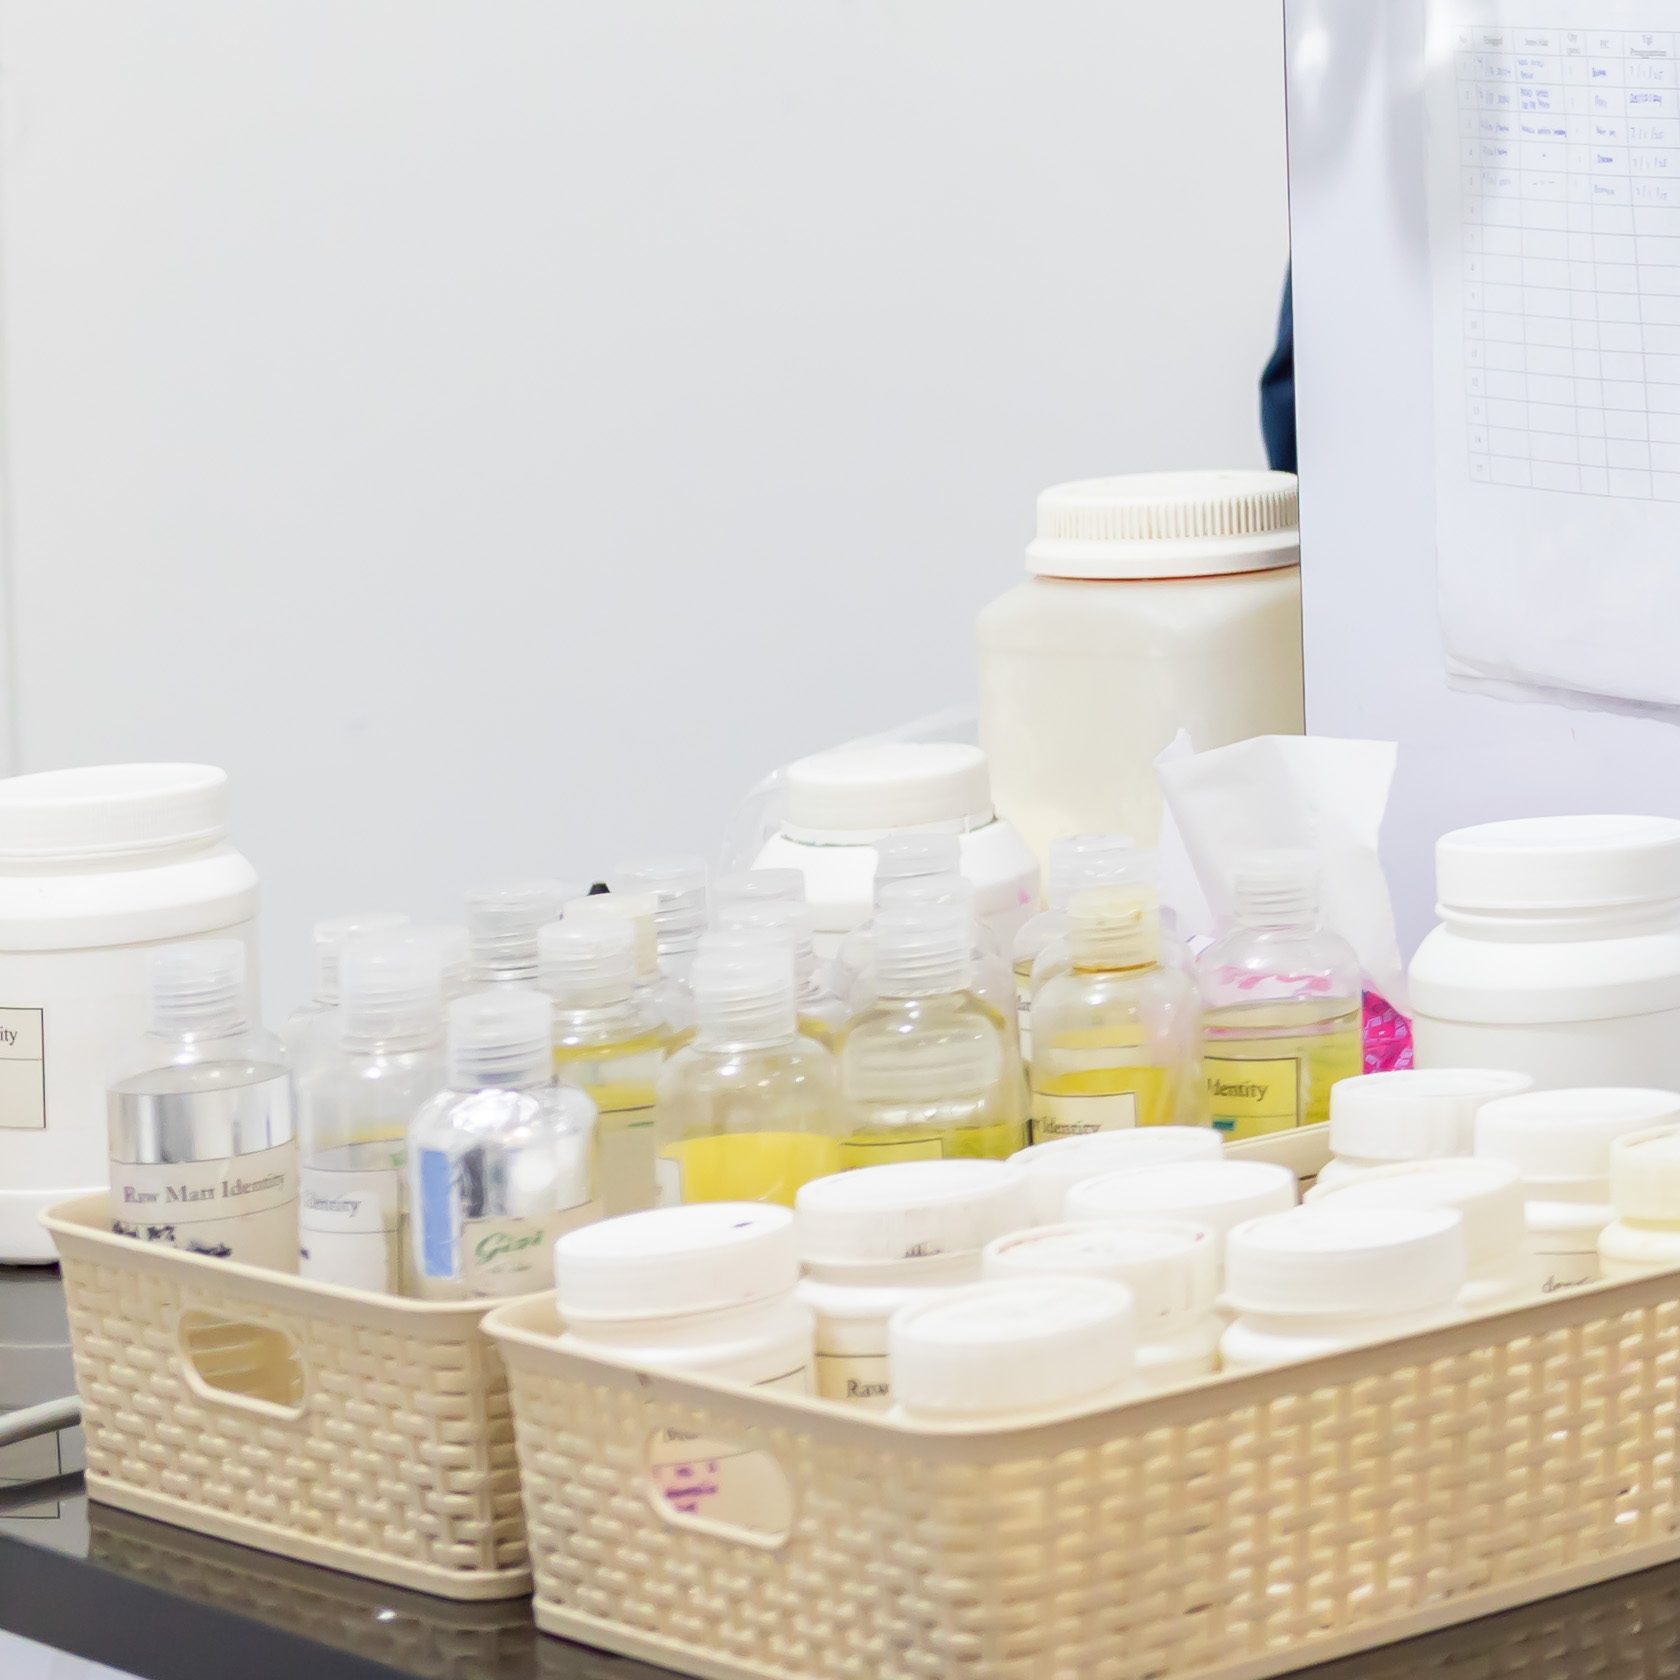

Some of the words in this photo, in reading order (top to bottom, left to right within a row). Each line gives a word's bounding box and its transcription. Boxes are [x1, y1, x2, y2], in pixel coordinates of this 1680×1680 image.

[122, 1185, 158, 1204] Raw
[164, 1185, 215, 1204] Matt
[846, 1378, 890, 1399] Raw
